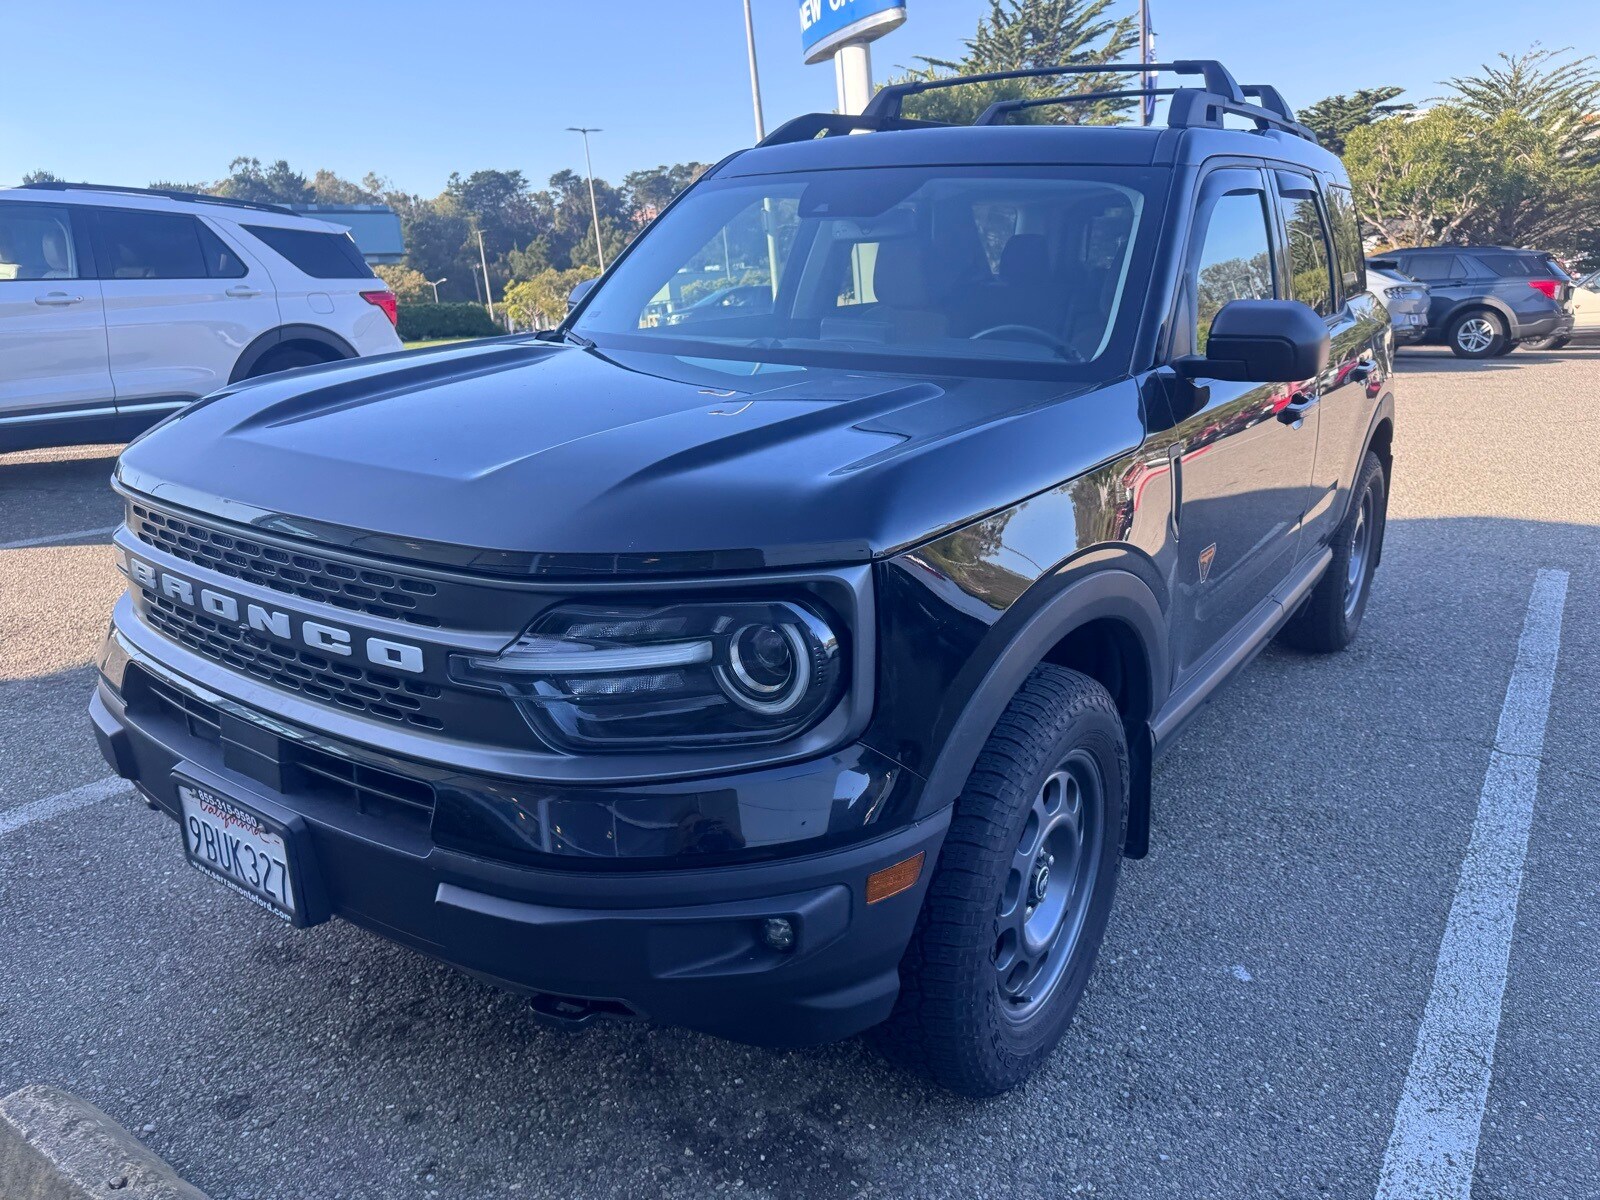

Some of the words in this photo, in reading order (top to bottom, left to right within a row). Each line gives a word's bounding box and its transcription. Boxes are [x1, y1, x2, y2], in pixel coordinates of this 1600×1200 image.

[131, 558, 424, 673] BRONCO
[198, 789, 258, 827] 855-315-9580
[189, 816, 287, 904] 9BUK327
[191, 860, 292, 922] www.serramonteford.com
